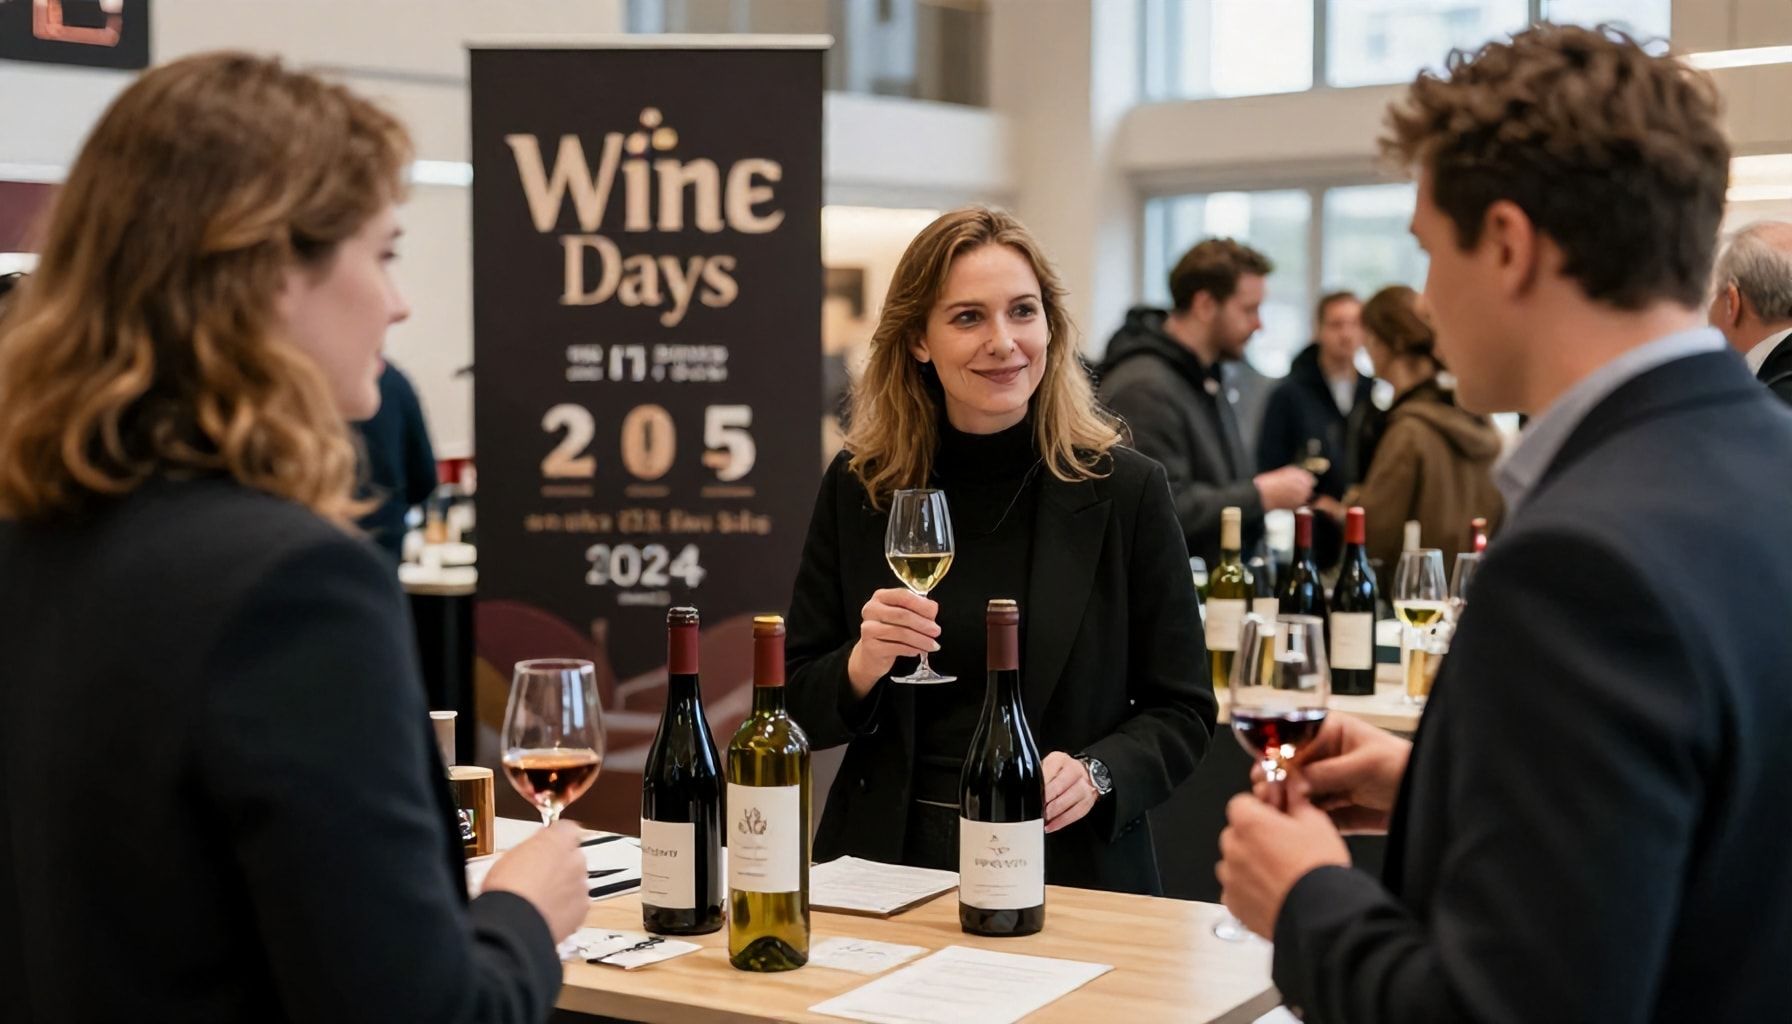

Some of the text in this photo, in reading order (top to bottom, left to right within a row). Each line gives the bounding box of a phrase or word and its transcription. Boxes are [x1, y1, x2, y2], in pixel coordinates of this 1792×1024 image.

[505, 132, 784, 233] Wine
[560, 235, 738, 327] Days
[584, 542, 707, 588] 2024
